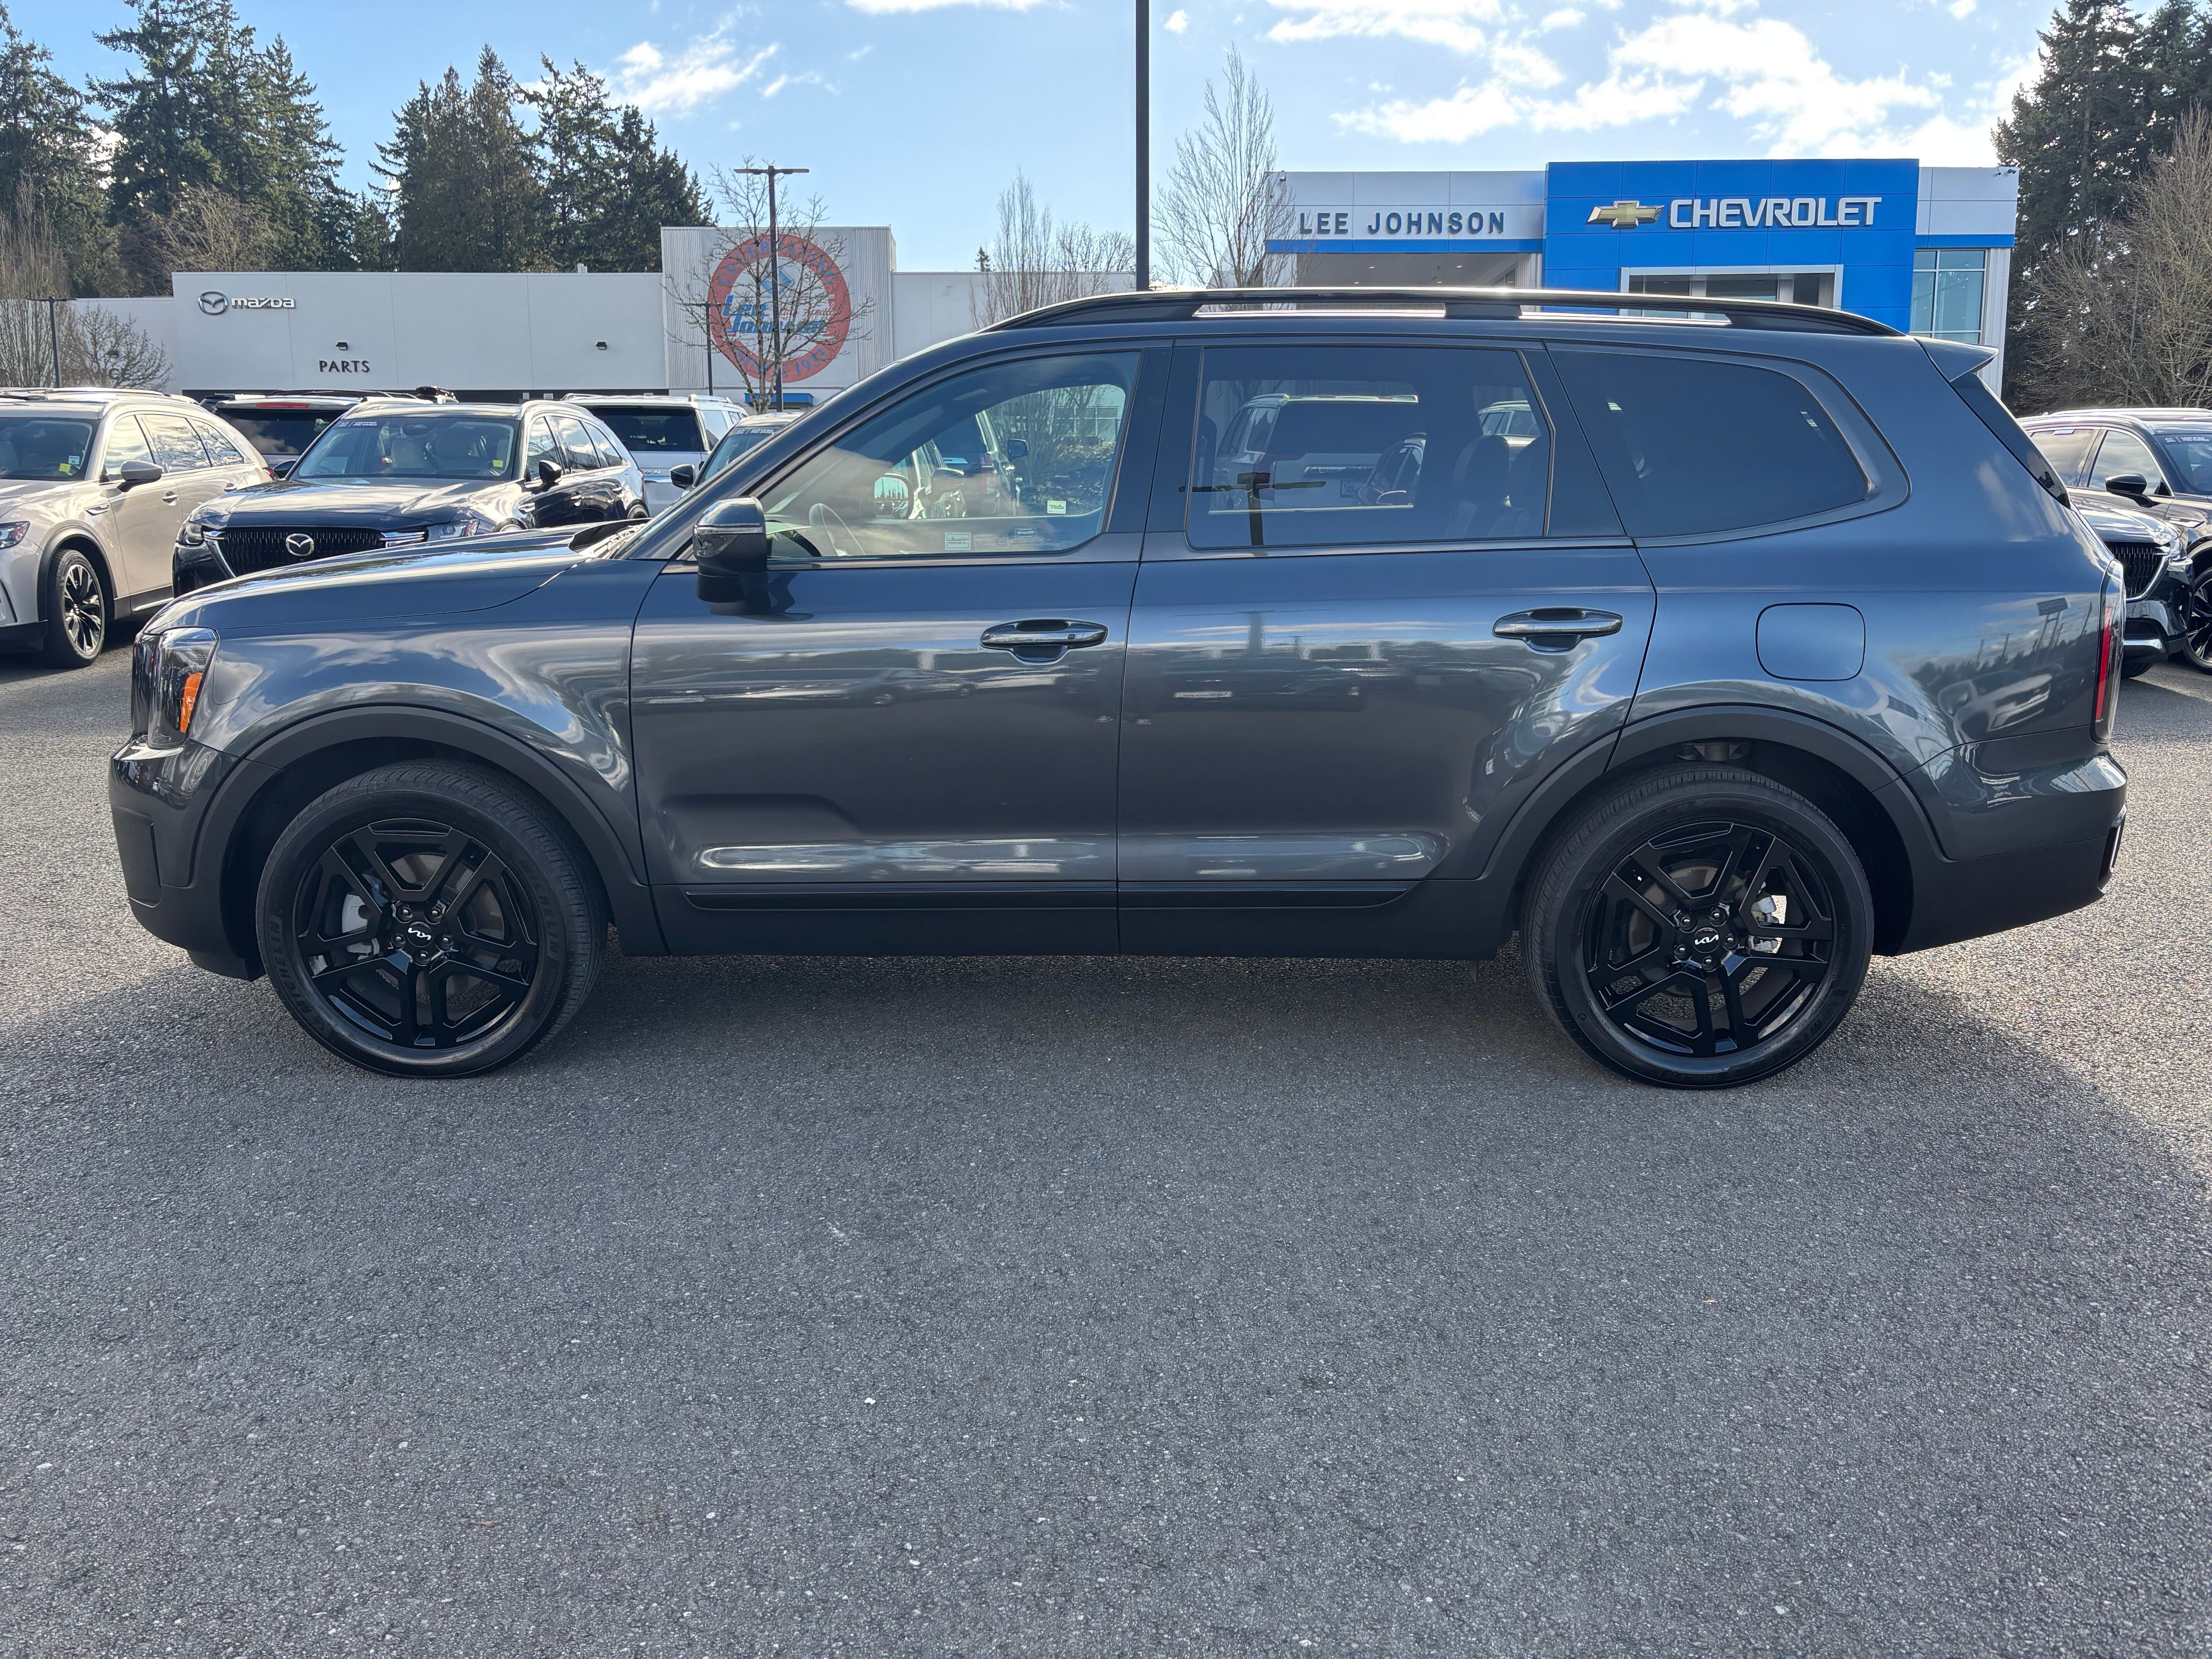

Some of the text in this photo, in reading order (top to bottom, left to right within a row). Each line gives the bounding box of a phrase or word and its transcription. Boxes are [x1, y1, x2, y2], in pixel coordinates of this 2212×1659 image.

[1300, 212, 1504, 235] LEE JOHNSON
[1670, 197, 1882, 228] CHEVROLET
[231, 297, 295, 309] mazda
[319, 360, 370, 373] PARTS
[794, 347, 828, 376] 1933
[518, 860, 559, 954] MICHELIN
[270, 921, 313, 1013] MICHELIN
